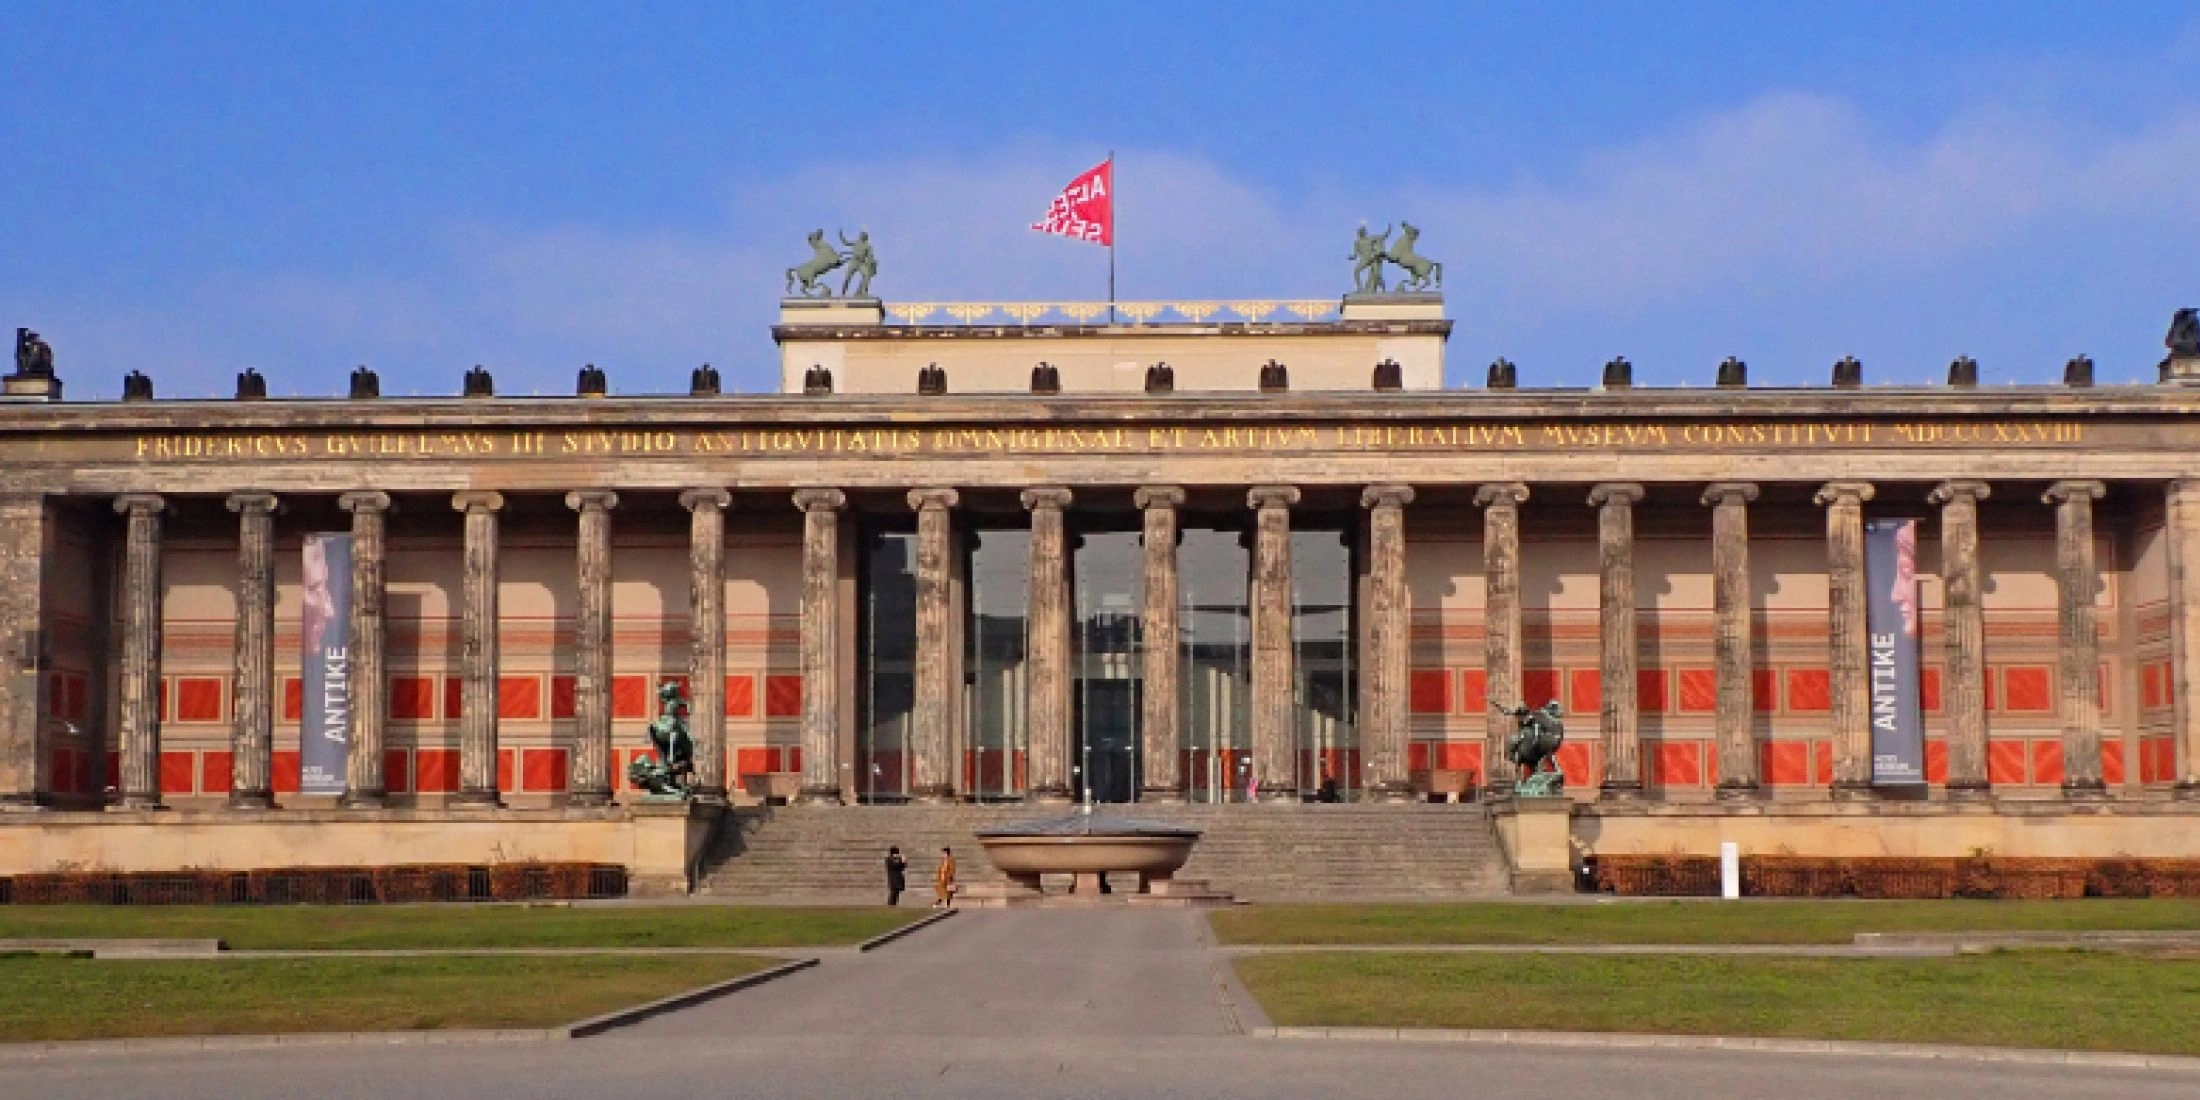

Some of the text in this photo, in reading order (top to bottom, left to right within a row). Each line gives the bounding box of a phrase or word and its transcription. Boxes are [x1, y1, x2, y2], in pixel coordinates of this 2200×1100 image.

[136, 434, 308, 456] FRIDERICVS
[512, 432, 544, 452] III
[562, 431, 675, 452] STVDIO
[695, 430, 920, 451] ANTIQVITATIS
[1149, 428, 1188, 448] ET
[1201, 427, 1319, 448] ARTIVM
[1336, 426, 1525, 446] LIBERALIVM
[1540, 424, 1669, 445] MVSEVM
[1684, 423, 1875, 443] CONSTITVIT
[325, 647, 346, 743] ANTIKE
[1874, 633, 1896, 730] ANTIKE
